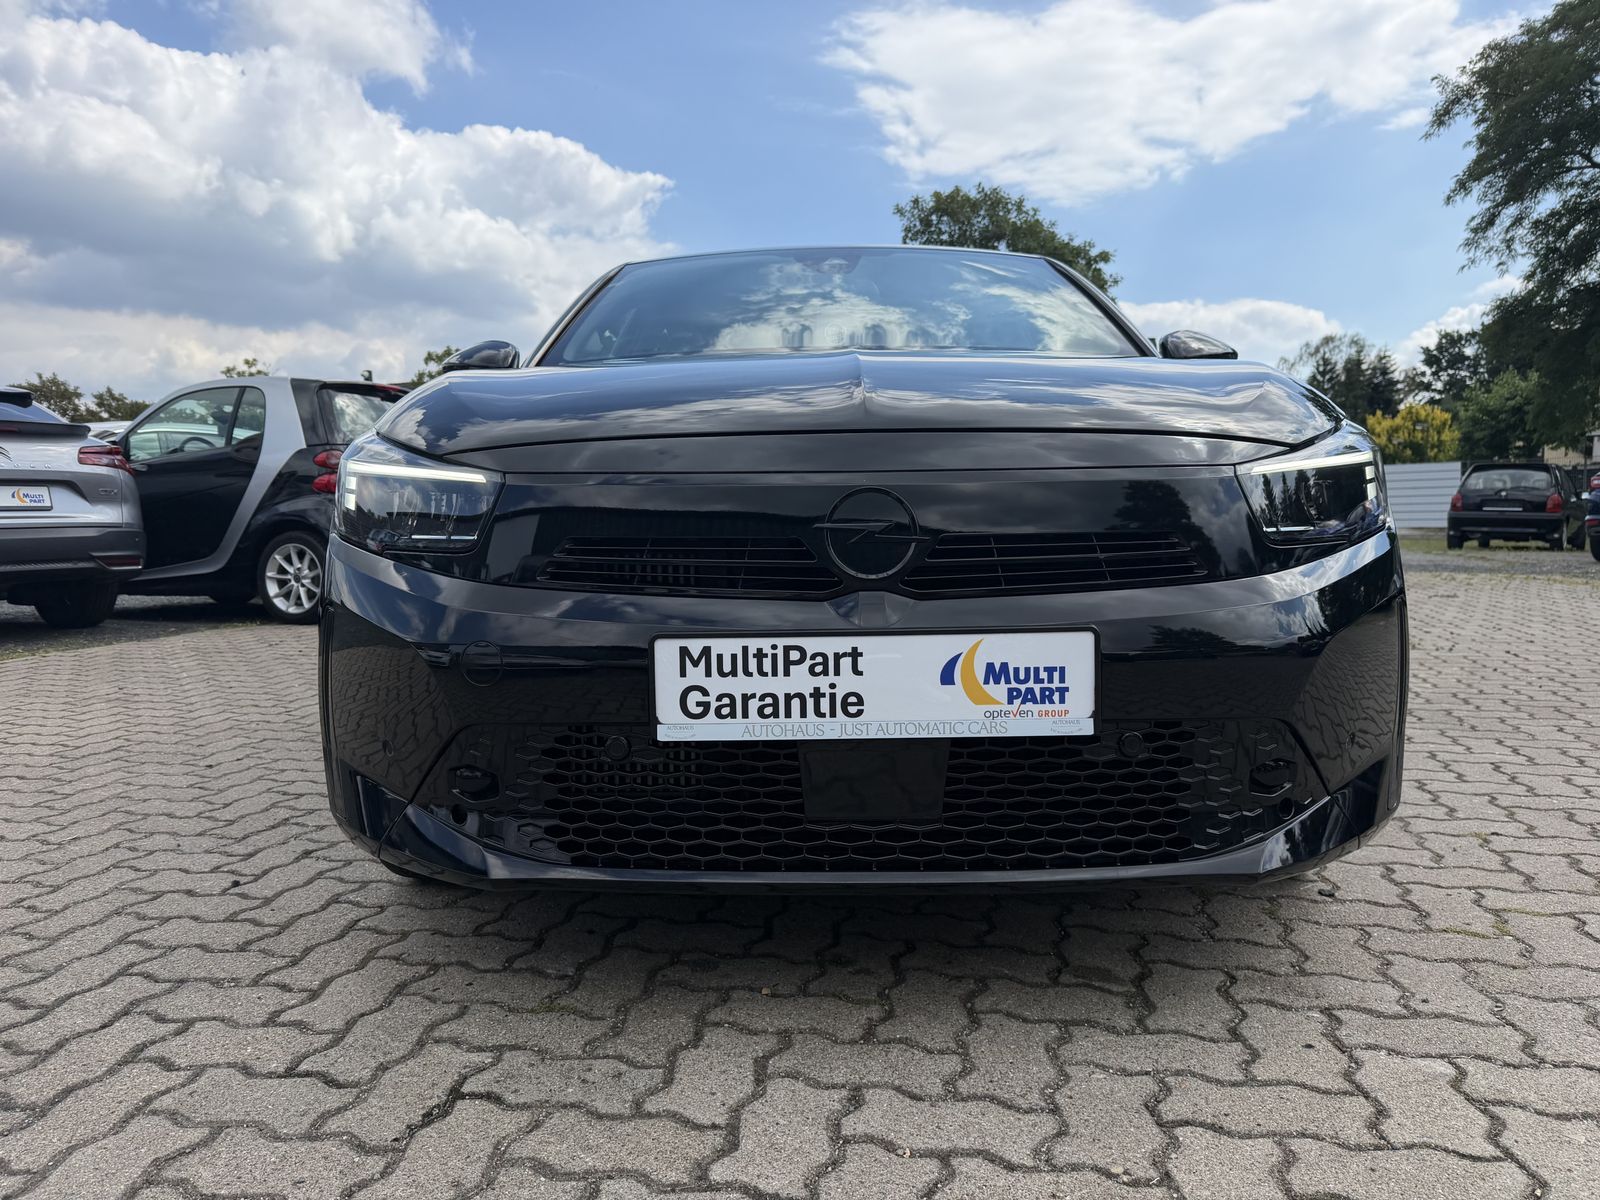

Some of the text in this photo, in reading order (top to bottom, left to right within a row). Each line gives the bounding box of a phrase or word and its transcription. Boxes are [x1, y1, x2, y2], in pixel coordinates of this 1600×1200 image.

[678, 644, 864, 678] MultiPart
[983, 661, 1066, 685] MULTI
[678, 683, 865, 720] Garantie
[1007, 687, 1070, 705] PART
[984, 706, 1070, 720] opteven GROUP
[741, 723, 825, 738] AUTOHAUS
[837, 722, 873, 738] JUST
[876, 722, 964, 736] AUTOMATIC
[967, 721, 1008, 735] CARS
